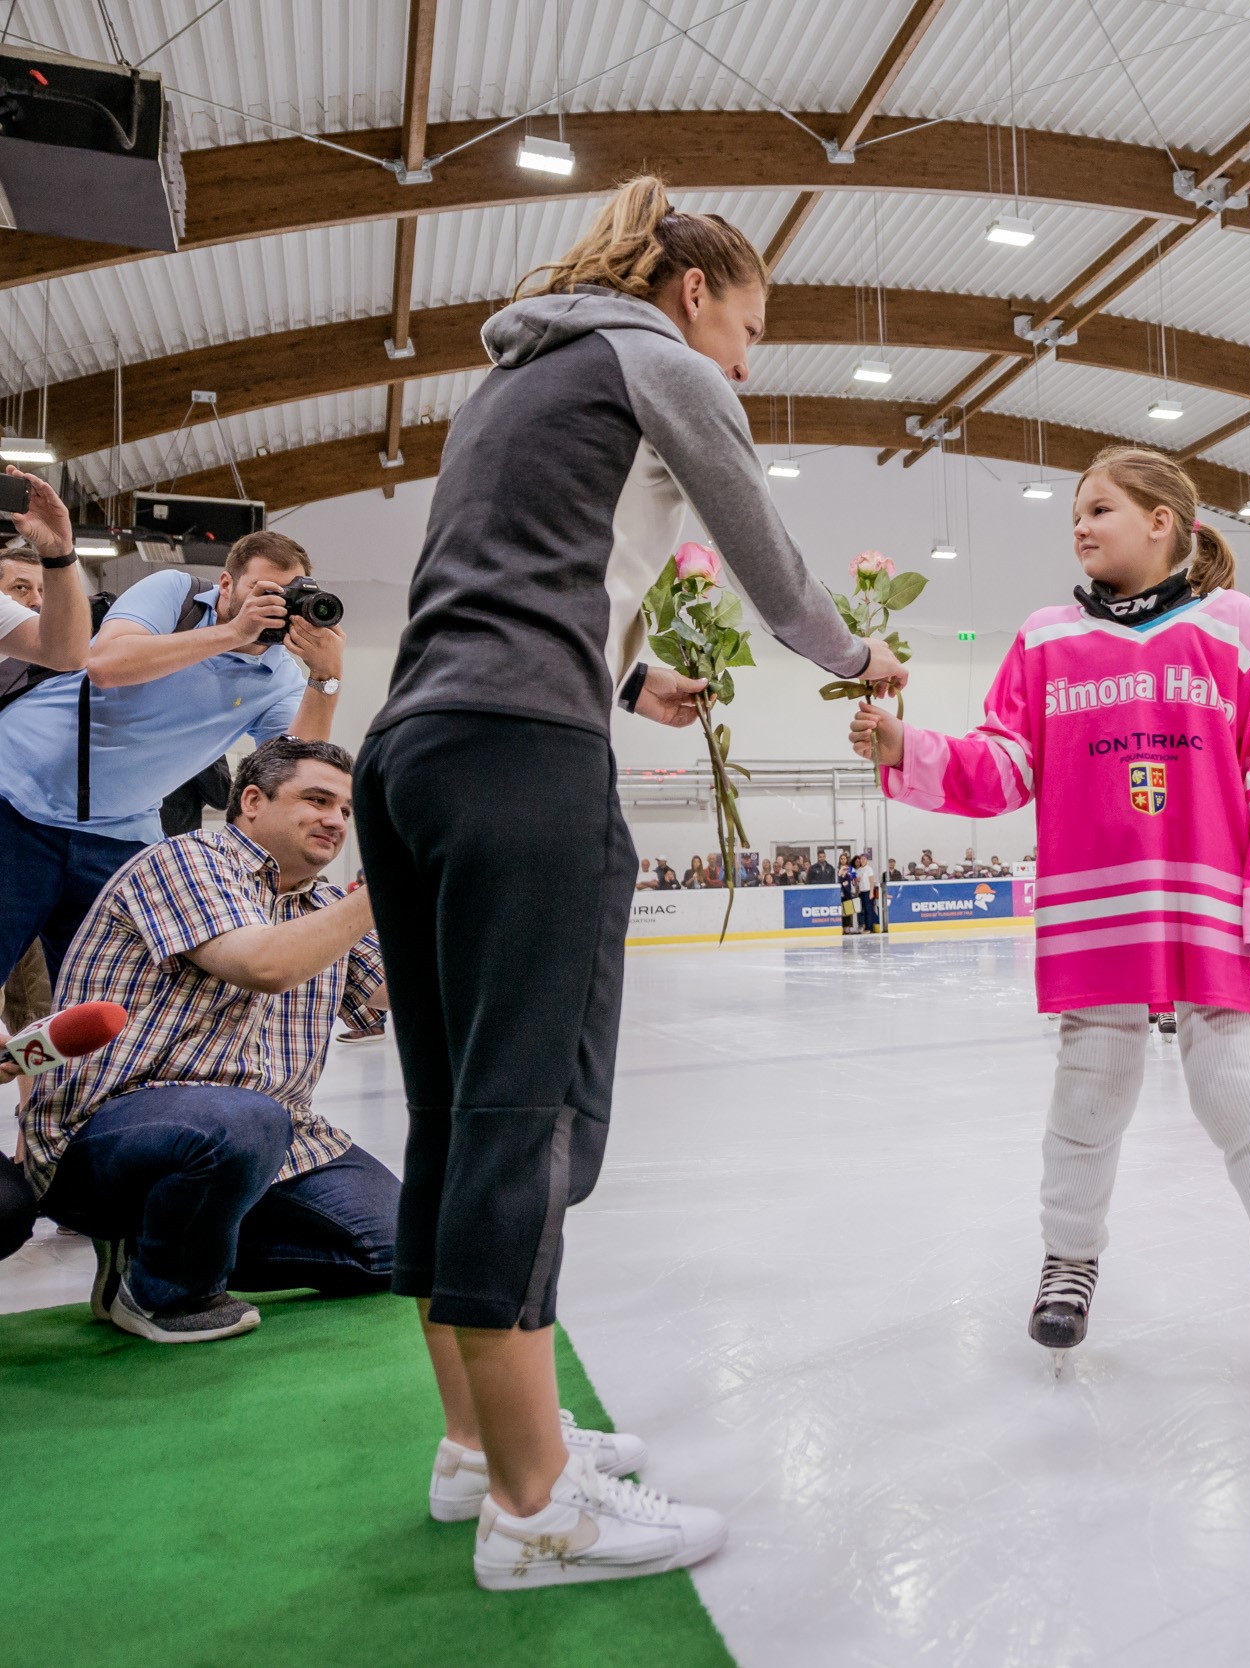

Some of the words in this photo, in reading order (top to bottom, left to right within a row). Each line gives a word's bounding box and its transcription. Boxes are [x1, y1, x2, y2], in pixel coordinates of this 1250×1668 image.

[1101, 594, 1158, 616] CM
[1045, 670, 1157, 719] Simona
[1088, 736, 1128, 756] ION
[632, 904, 677, 915] IRIAC
[911, 899, 974, 913] DEDEMAN
